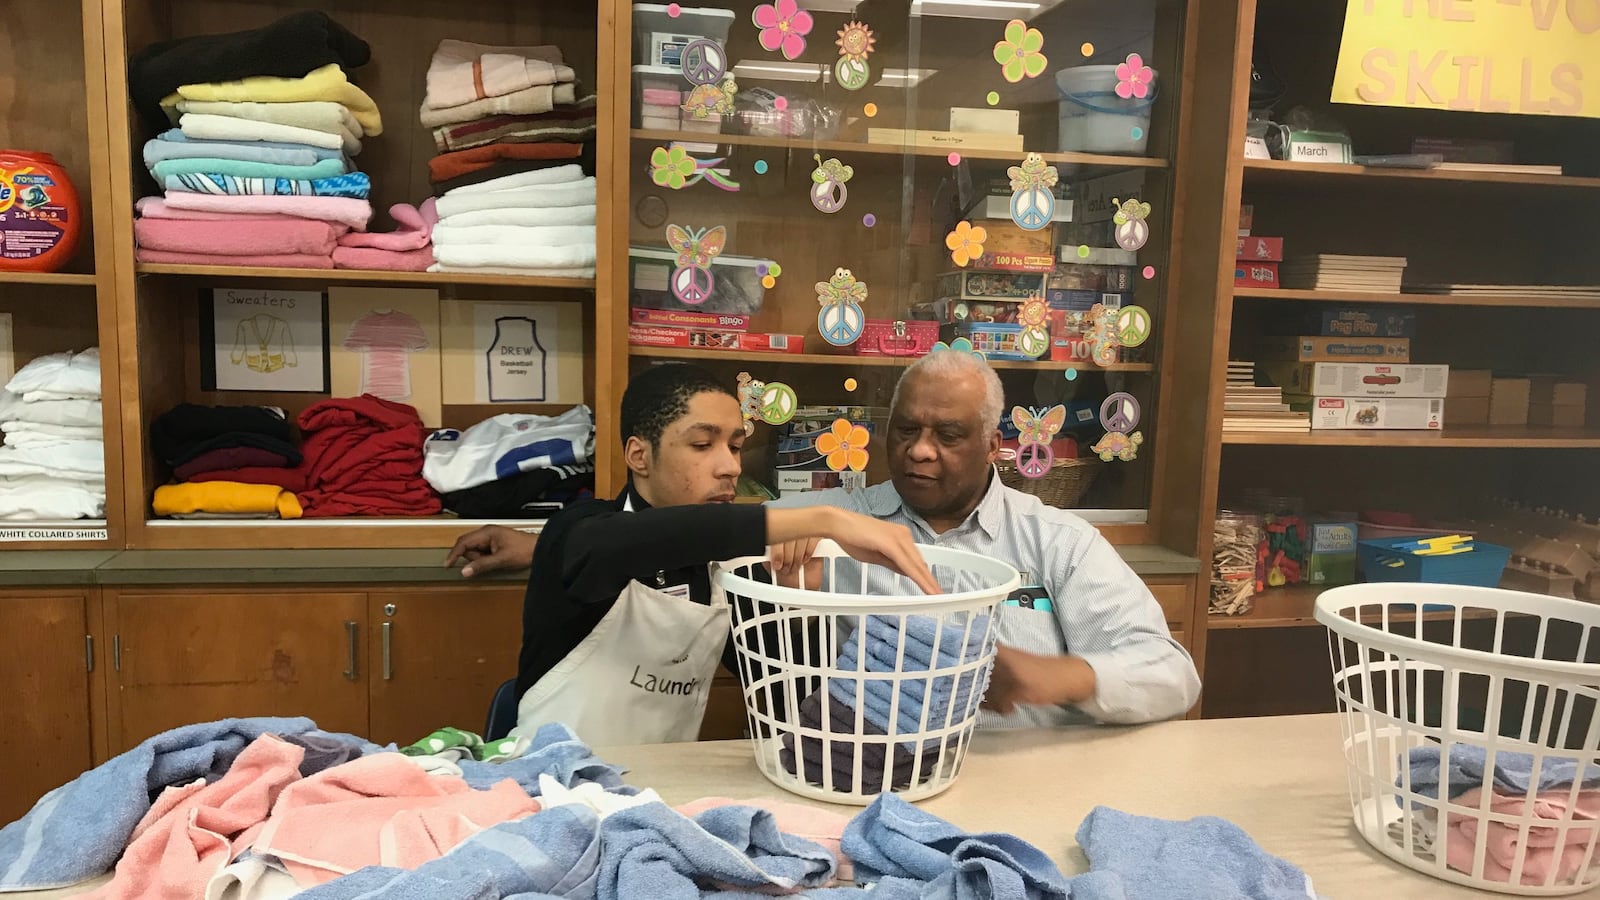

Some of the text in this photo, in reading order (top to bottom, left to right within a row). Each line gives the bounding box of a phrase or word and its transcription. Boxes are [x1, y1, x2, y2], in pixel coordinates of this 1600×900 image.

[1356, 47, 1584, 115] SKILLS
[1297, 146, 1328, 156] March
[16, 176, 33, 184] 70%
[996, 255, 1011, 265] 100
[226, 290, 297, 309] Sweaters
[669, 313, 717, 324] Consonants
[719, 316, 743, 326] Bingo
[1329, 319, 1378, 335] Peg Play
[501, 346, 533, 355] DREW
[1070, 340, 1094, 359] 10
